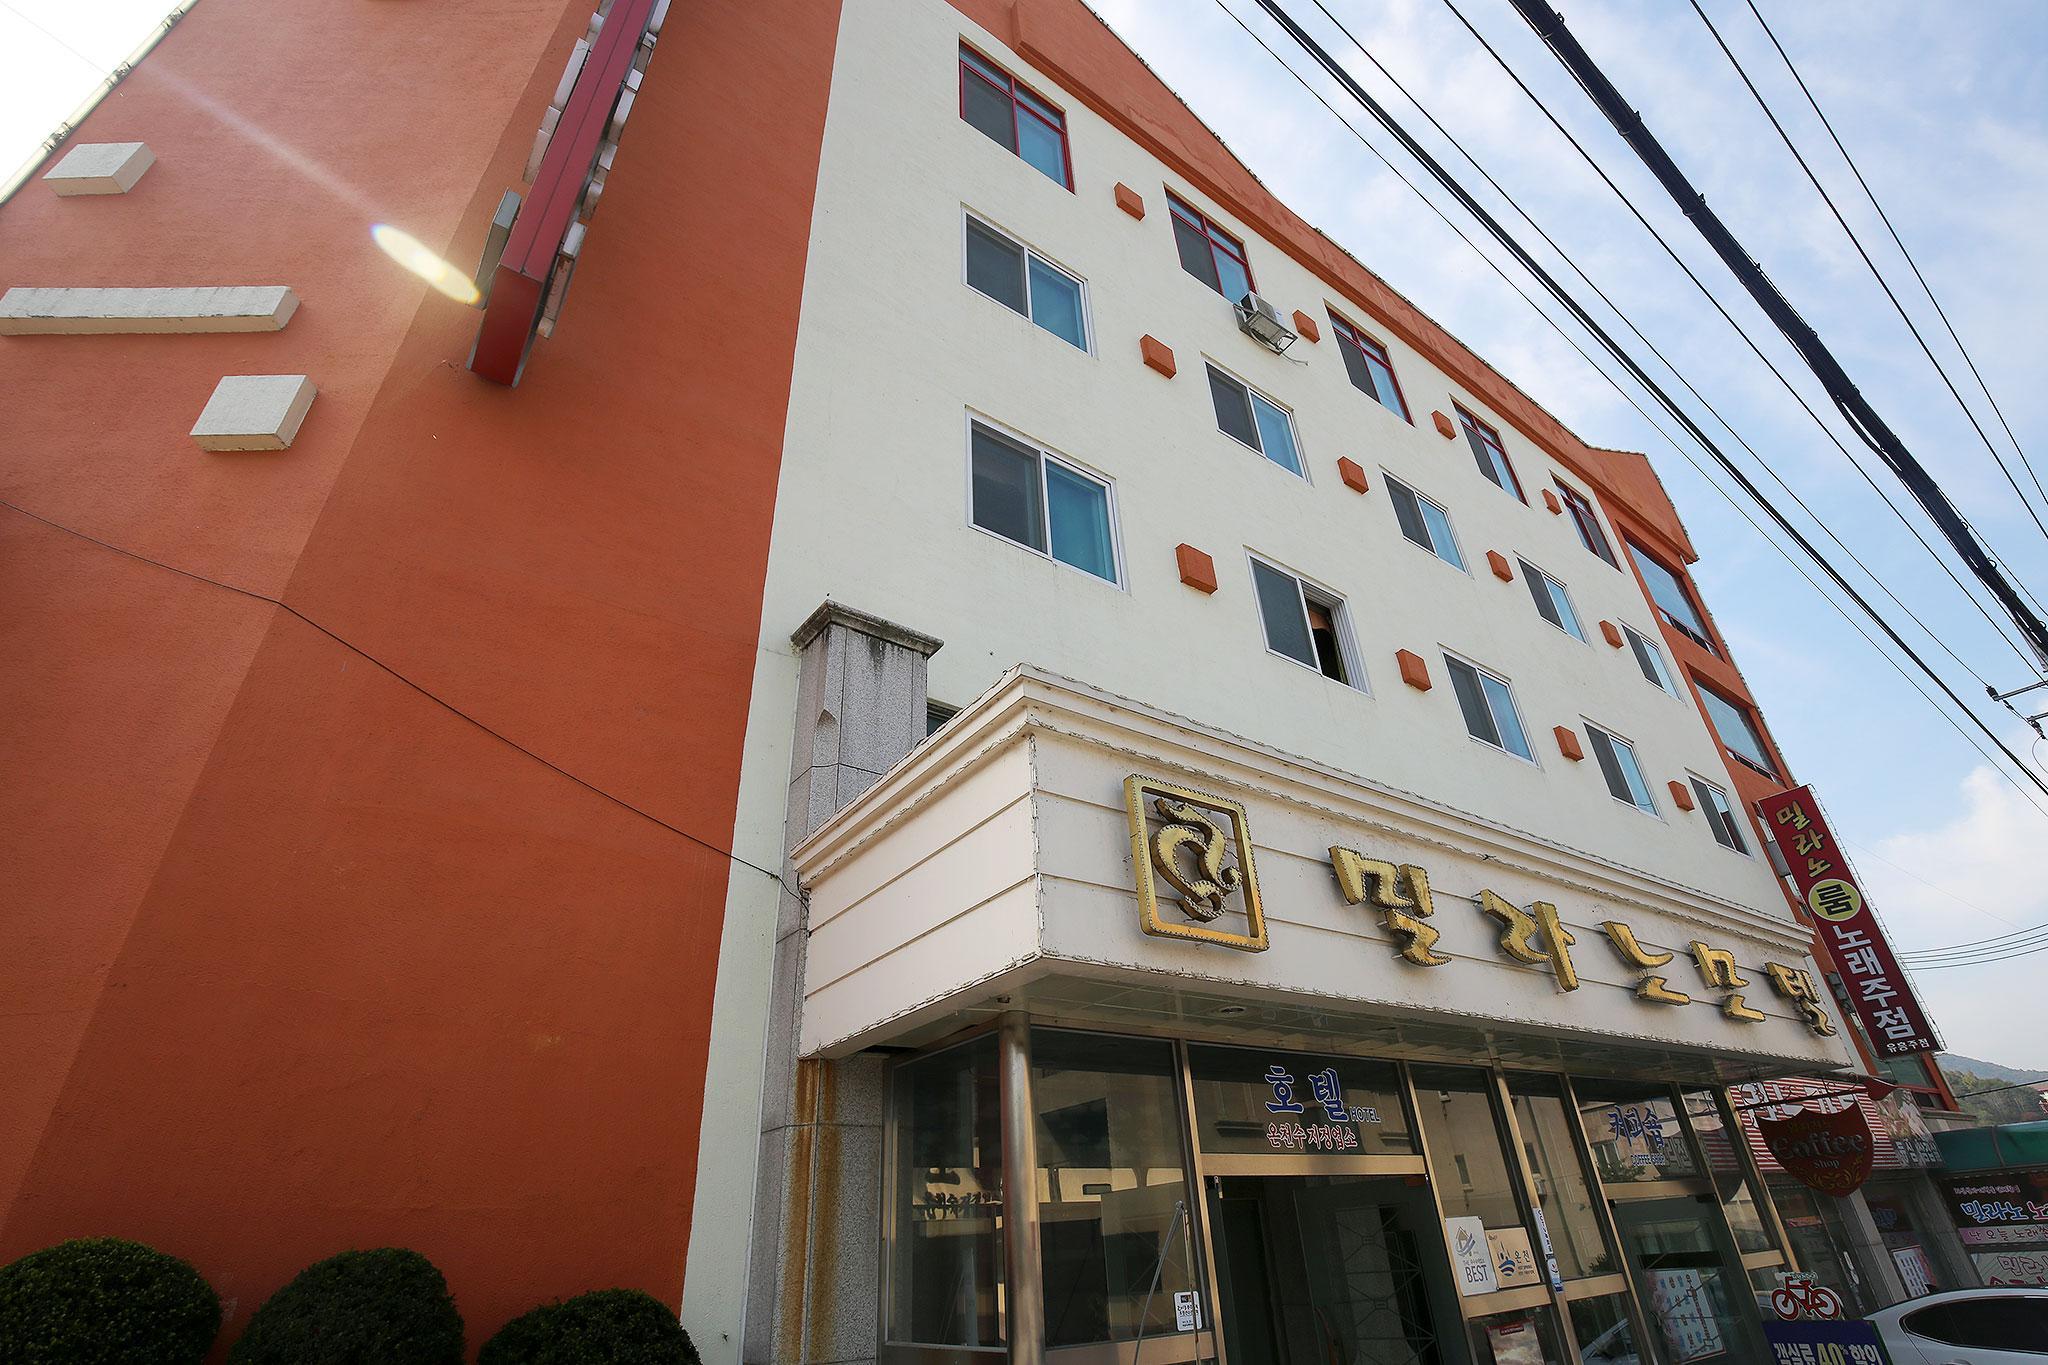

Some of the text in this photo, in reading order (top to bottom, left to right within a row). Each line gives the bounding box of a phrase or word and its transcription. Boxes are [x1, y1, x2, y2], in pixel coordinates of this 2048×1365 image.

[1775, 800, 1916, 1039] 밀라노 룸 노래주점
[1886, 1038, 1930, 1053] 유흥주점
[1264, 1065, 1349, 1122] 호텔
[1349, 1106, 1381, 1123] HOTEL
[1608, 1105, 1665, 1149] 커피숍
[1960, 1200, 2048, 1224] 밀라노 노
[1968, 1231, 1981, 1241] 난
[1986, 1228, 2009, 1241] 오늘
[1464, 1264, 1489, 1284] BEST
